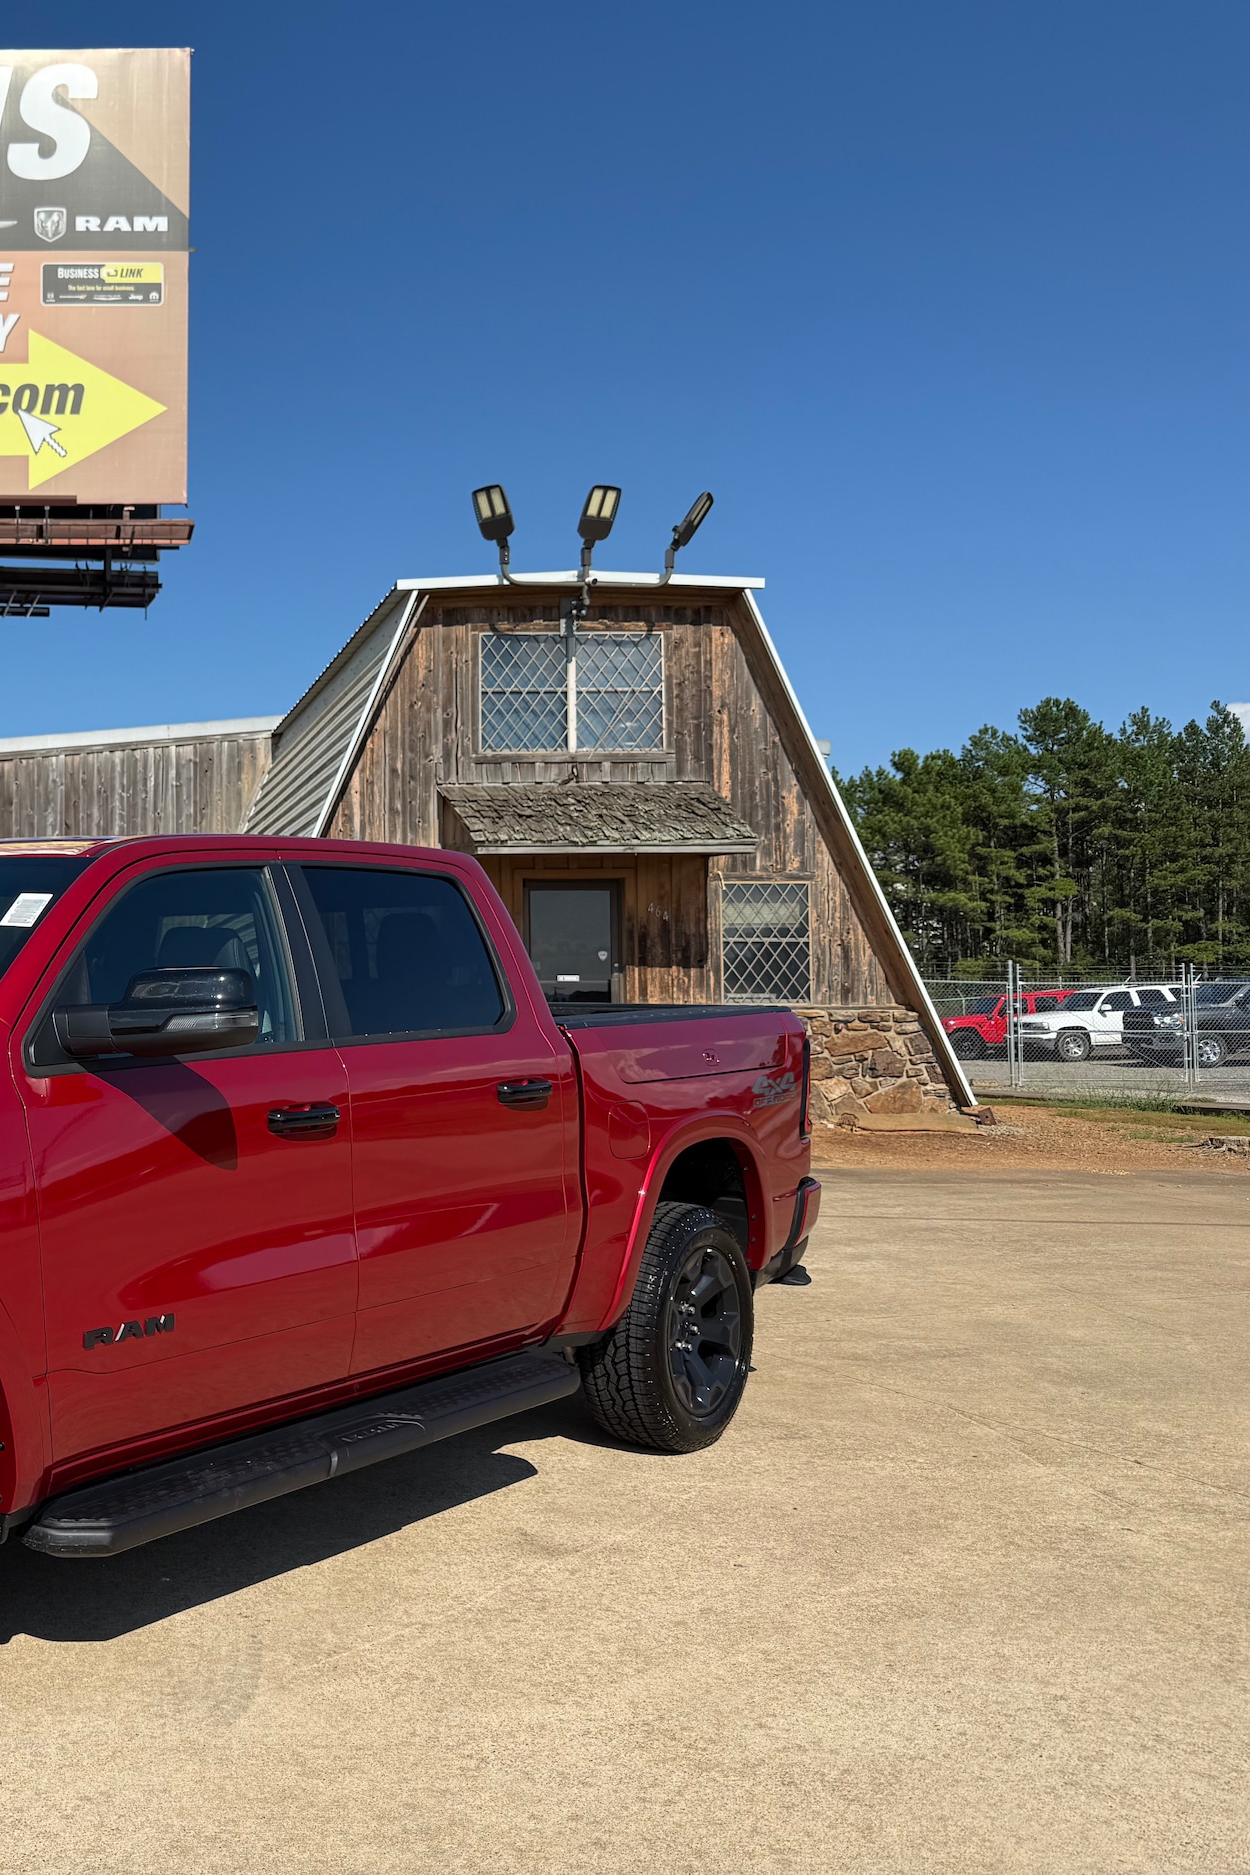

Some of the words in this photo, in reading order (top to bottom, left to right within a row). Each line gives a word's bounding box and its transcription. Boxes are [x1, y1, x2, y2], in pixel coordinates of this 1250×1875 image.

[75, 215, 169, 232] RAM
[119, 268, 144, 279] LINK
[647, 902, 669, 922] 464
[83, 1313, 175, 1350] RAM
